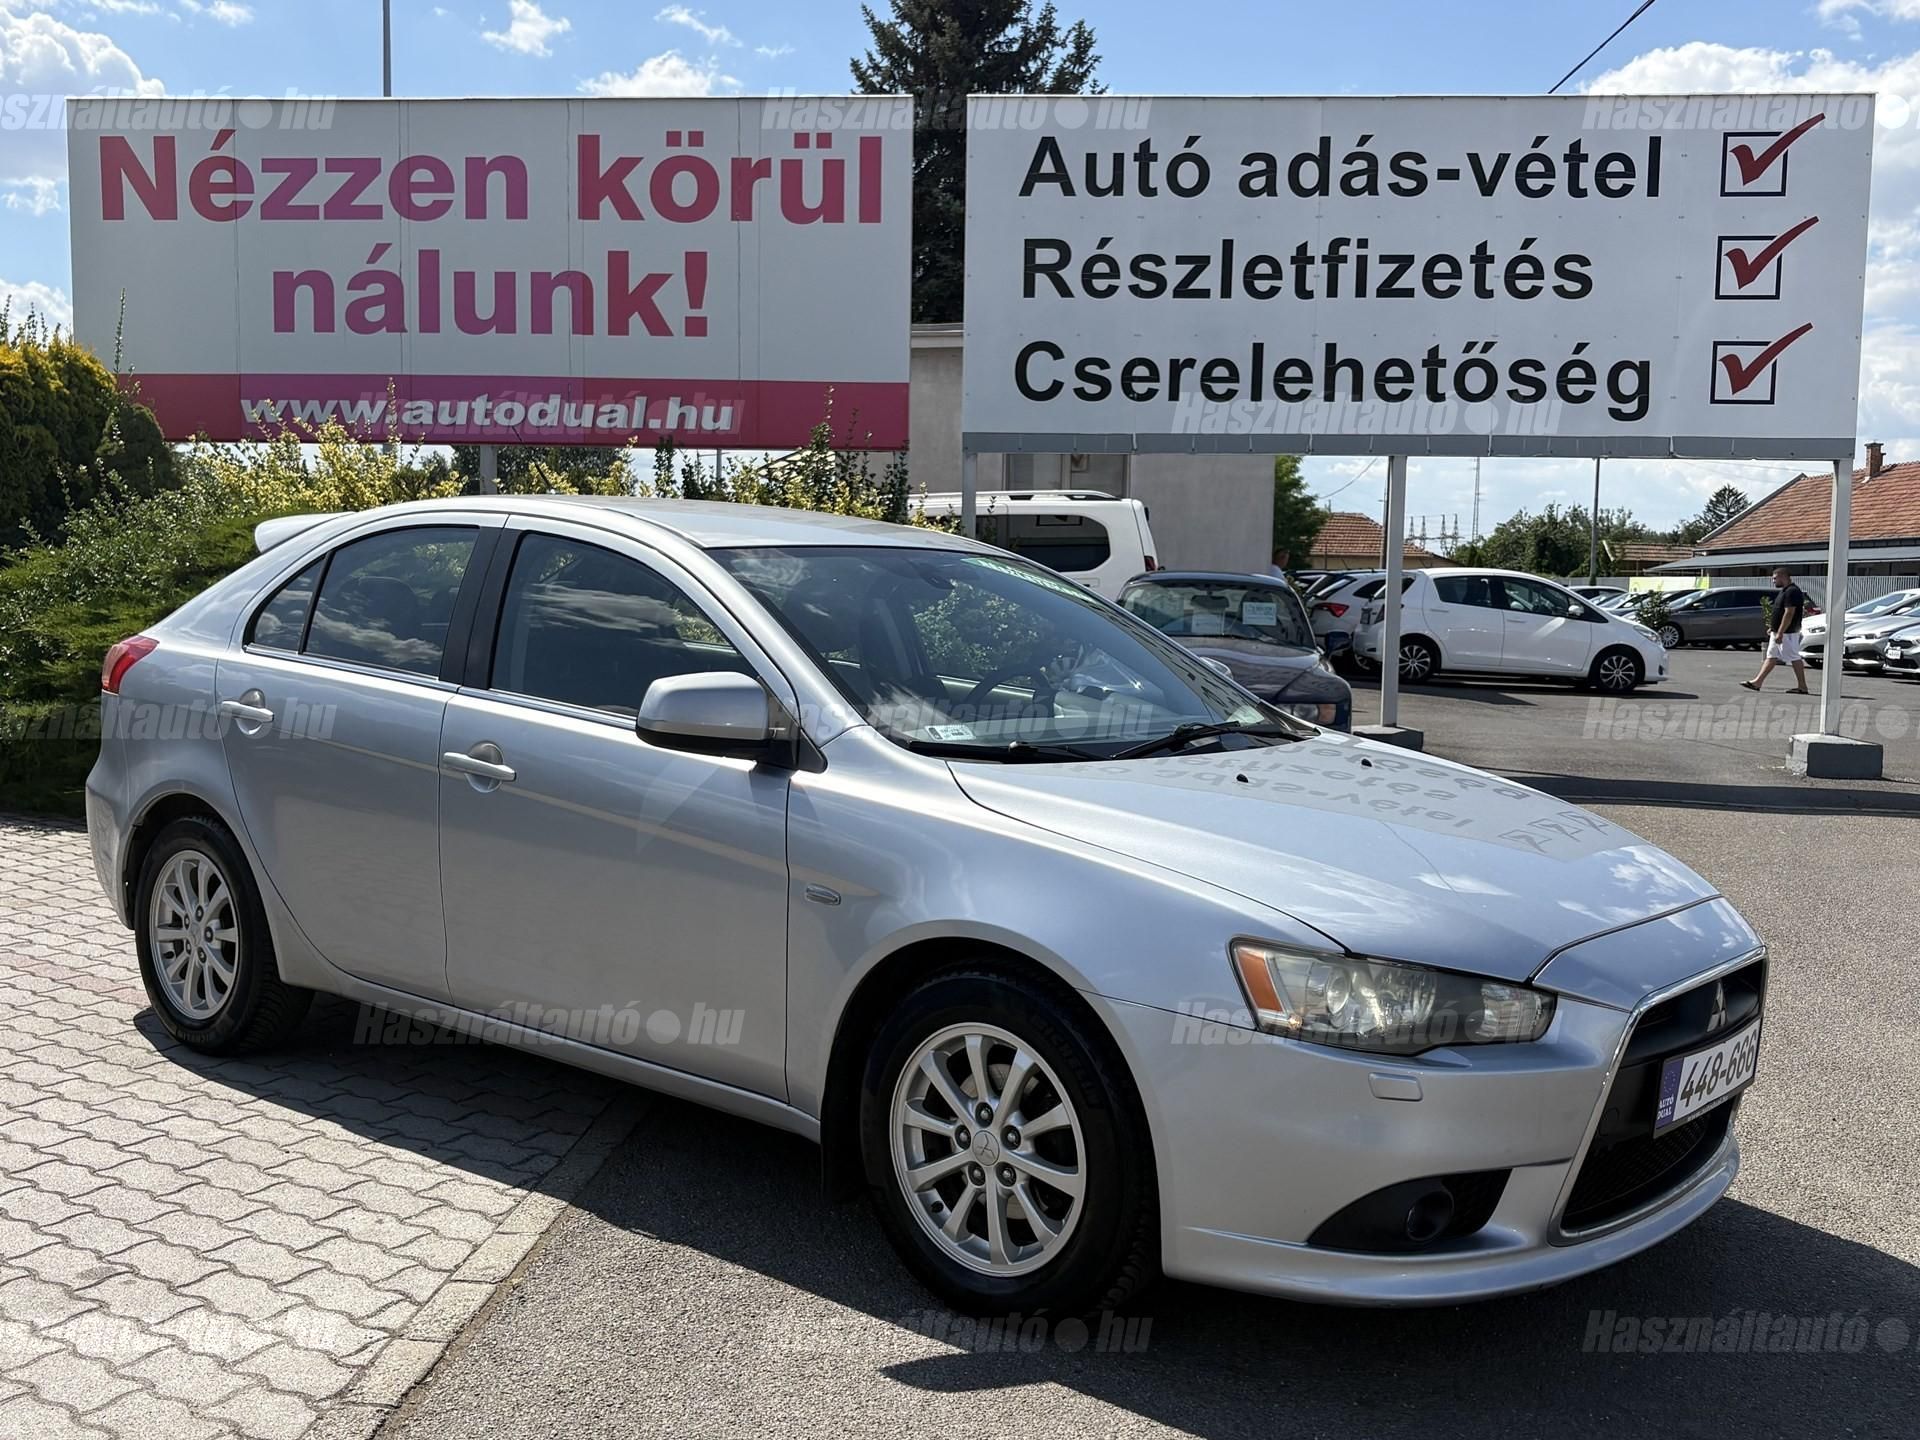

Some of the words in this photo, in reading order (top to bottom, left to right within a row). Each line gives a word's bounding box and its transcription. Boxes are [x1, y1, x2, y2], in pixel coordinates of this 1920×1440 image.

[99, 130, 528, 222] Nézzen
[577, 131, 883, 224] körül
[1019, 134, 1212, 199] Autó
[1238, 132, 1662, 200] adás-vétel
[271, 242, 709, 338] nálunk!
[1021, 236, 1594, 300] Részletfizetés
[240, 393, 735, 433] www.autodual.hu
[1013, 340, 1652, 421] Cserelehetőség
[1680, 1028, 1758, 1108] 448-666
